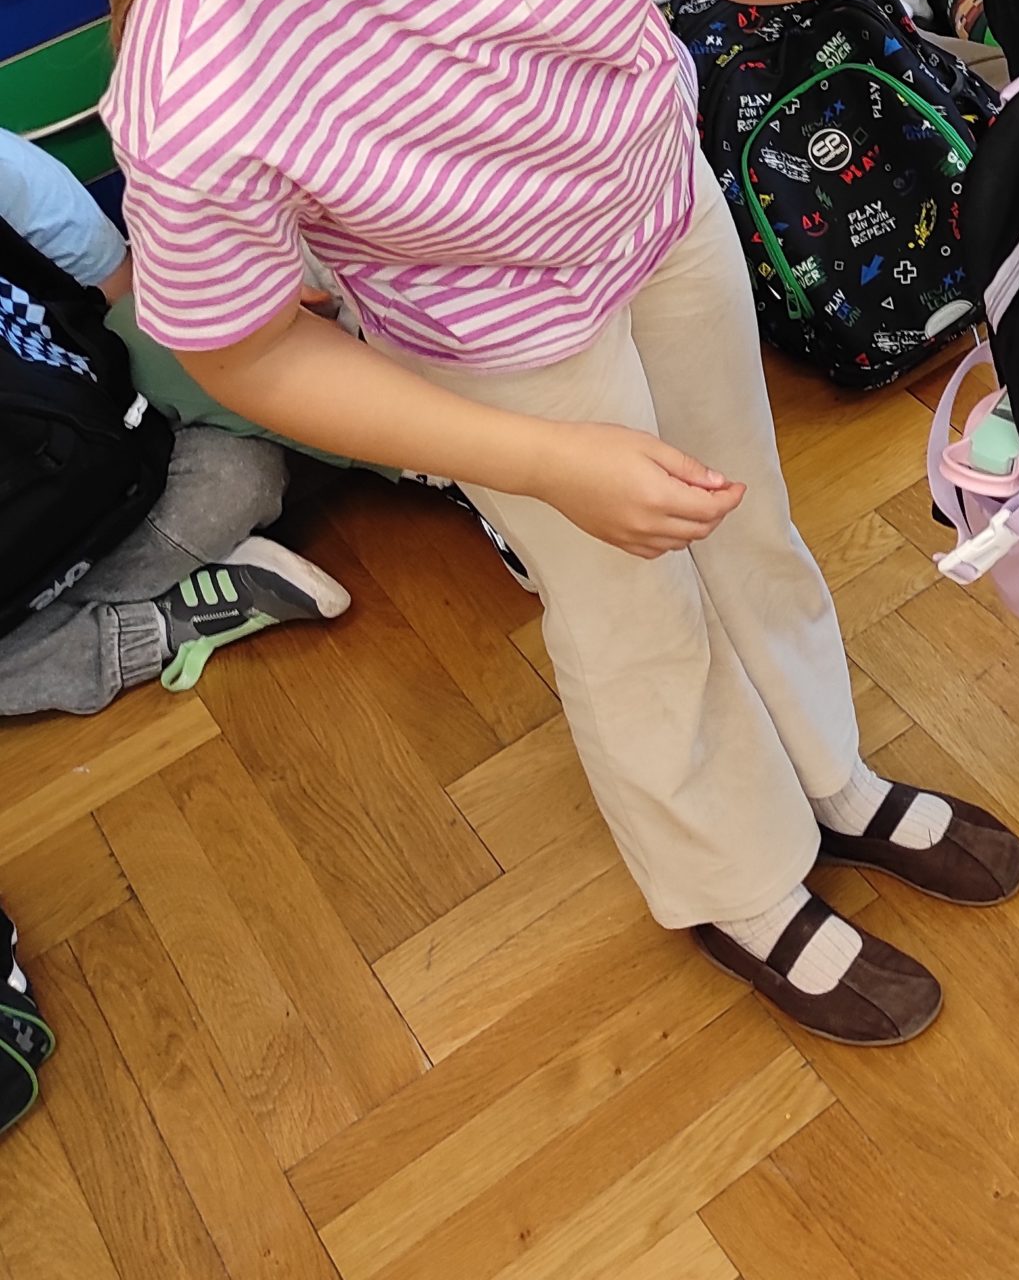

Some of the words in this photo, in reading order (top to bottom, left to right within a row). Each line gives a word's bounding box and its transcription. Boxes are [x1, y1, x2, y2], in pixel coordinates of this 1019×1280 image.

[739, 93, 772, 108] PLAY
[868, 81, 883, 119] PLAY
[738, 107, 757, 119] FUN
[847, 200, 882, 225] PLAY
[849, 220, 868, 235] FUN
[870, 210, 889, 225] WIN
[850, 216, 896, 248] REPEAT
[791, 256, 817, 279] AME
[798, 269, 821, 289] VER
[824, 288, 846, 316] PLAY
